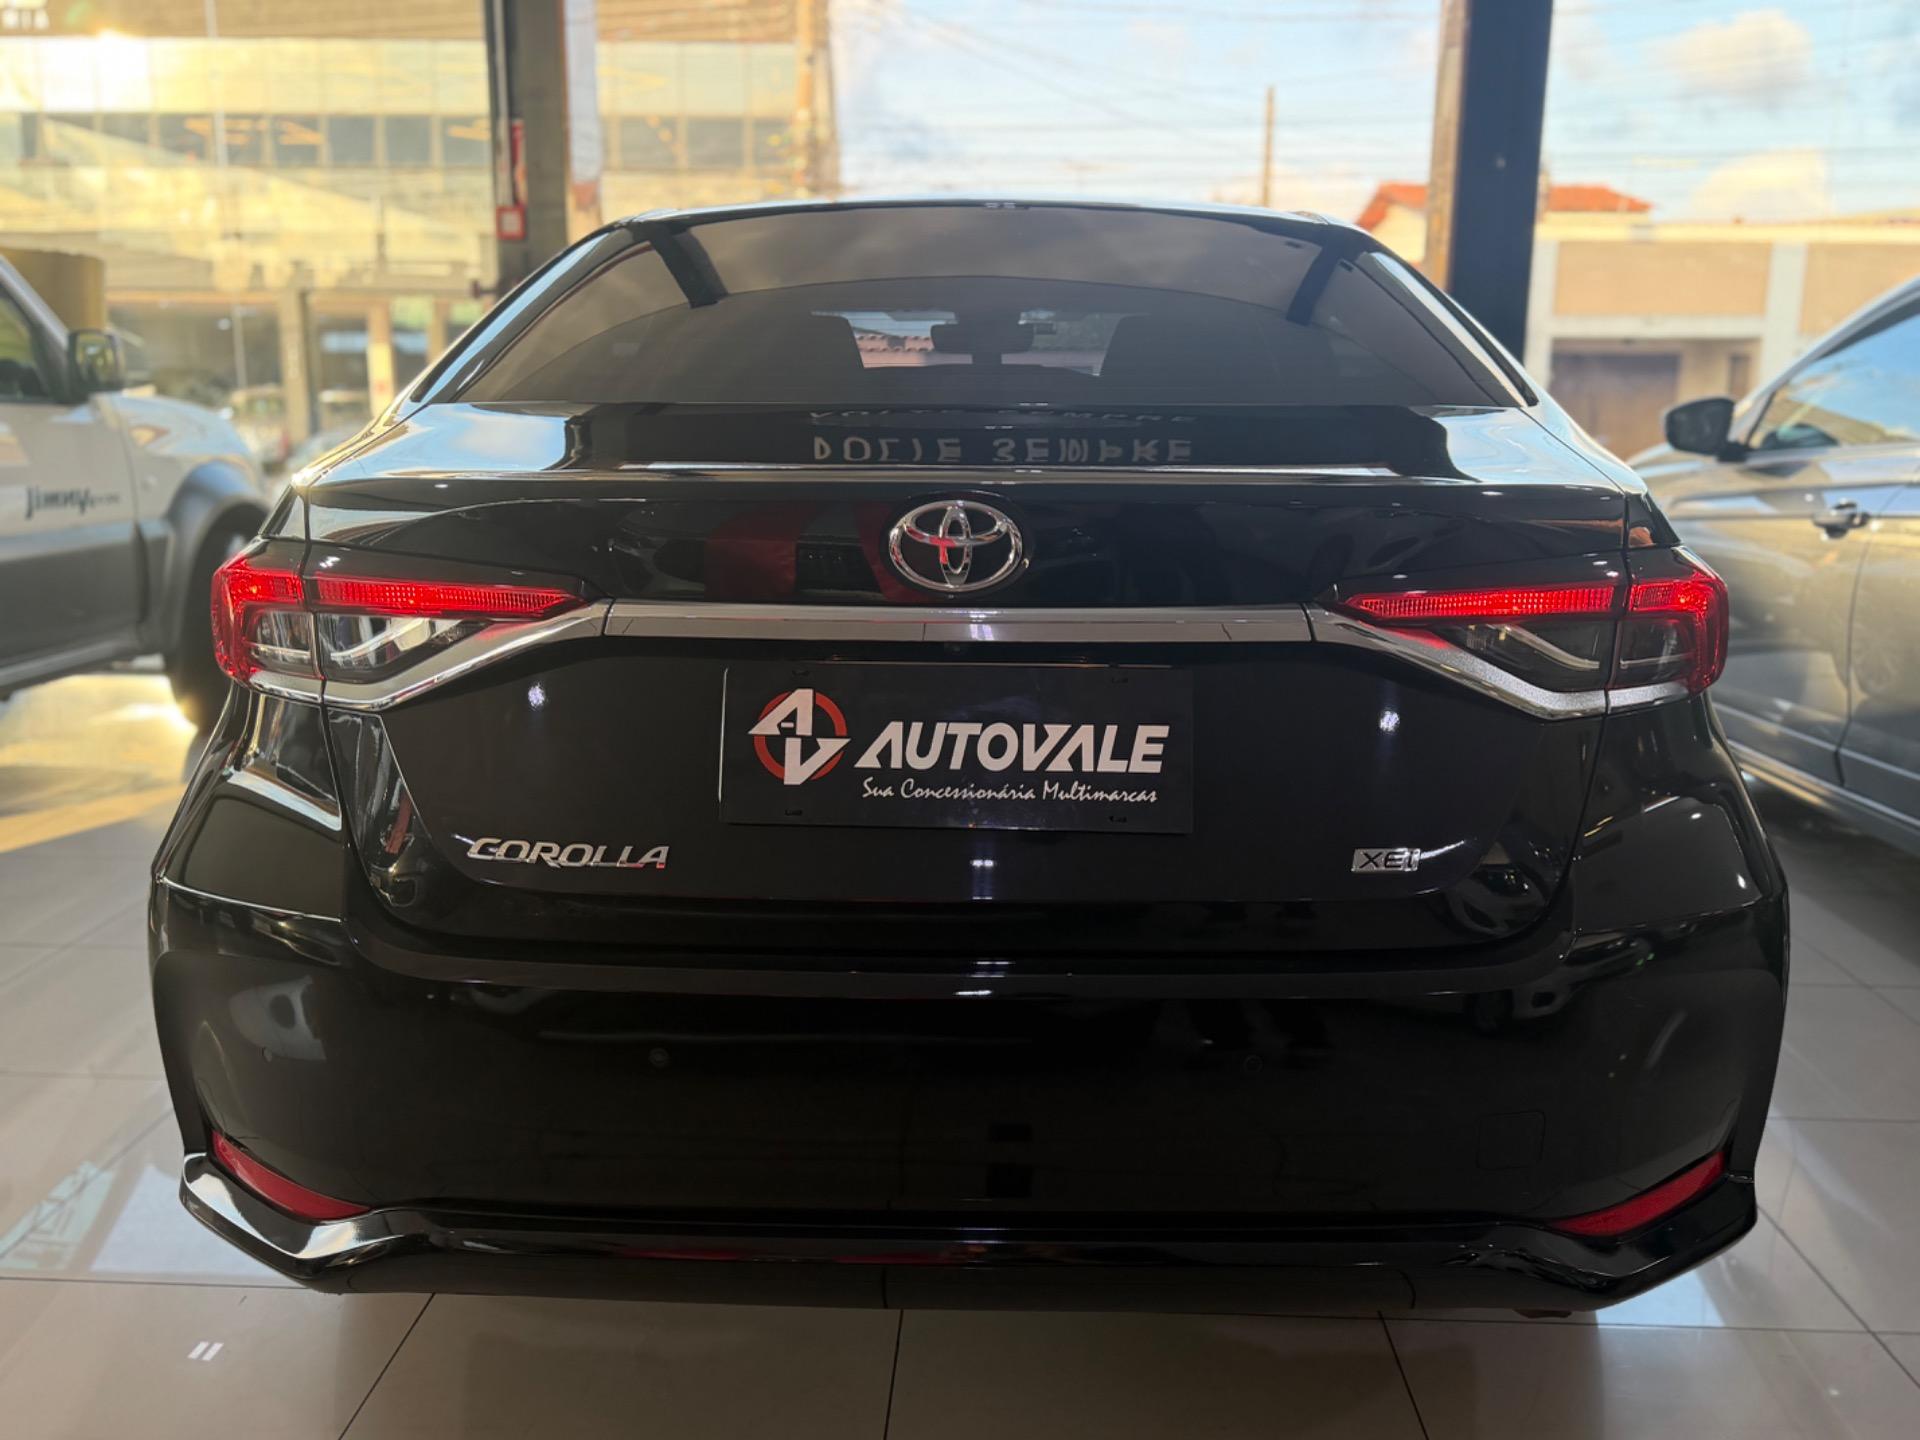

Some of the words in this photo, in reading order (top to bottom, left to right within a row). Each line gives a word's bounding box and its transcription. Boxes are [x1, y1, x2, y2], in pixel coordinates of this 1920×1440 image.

[854, 721, 1170, 773] AUTOVALE
[862, 776, 895, 799] Sua
[901, 778, 1036, 799] Concessionária
[1042, 780, 1158, 803] Multimarcas
[467, 837, 670, 869] COROLLA
